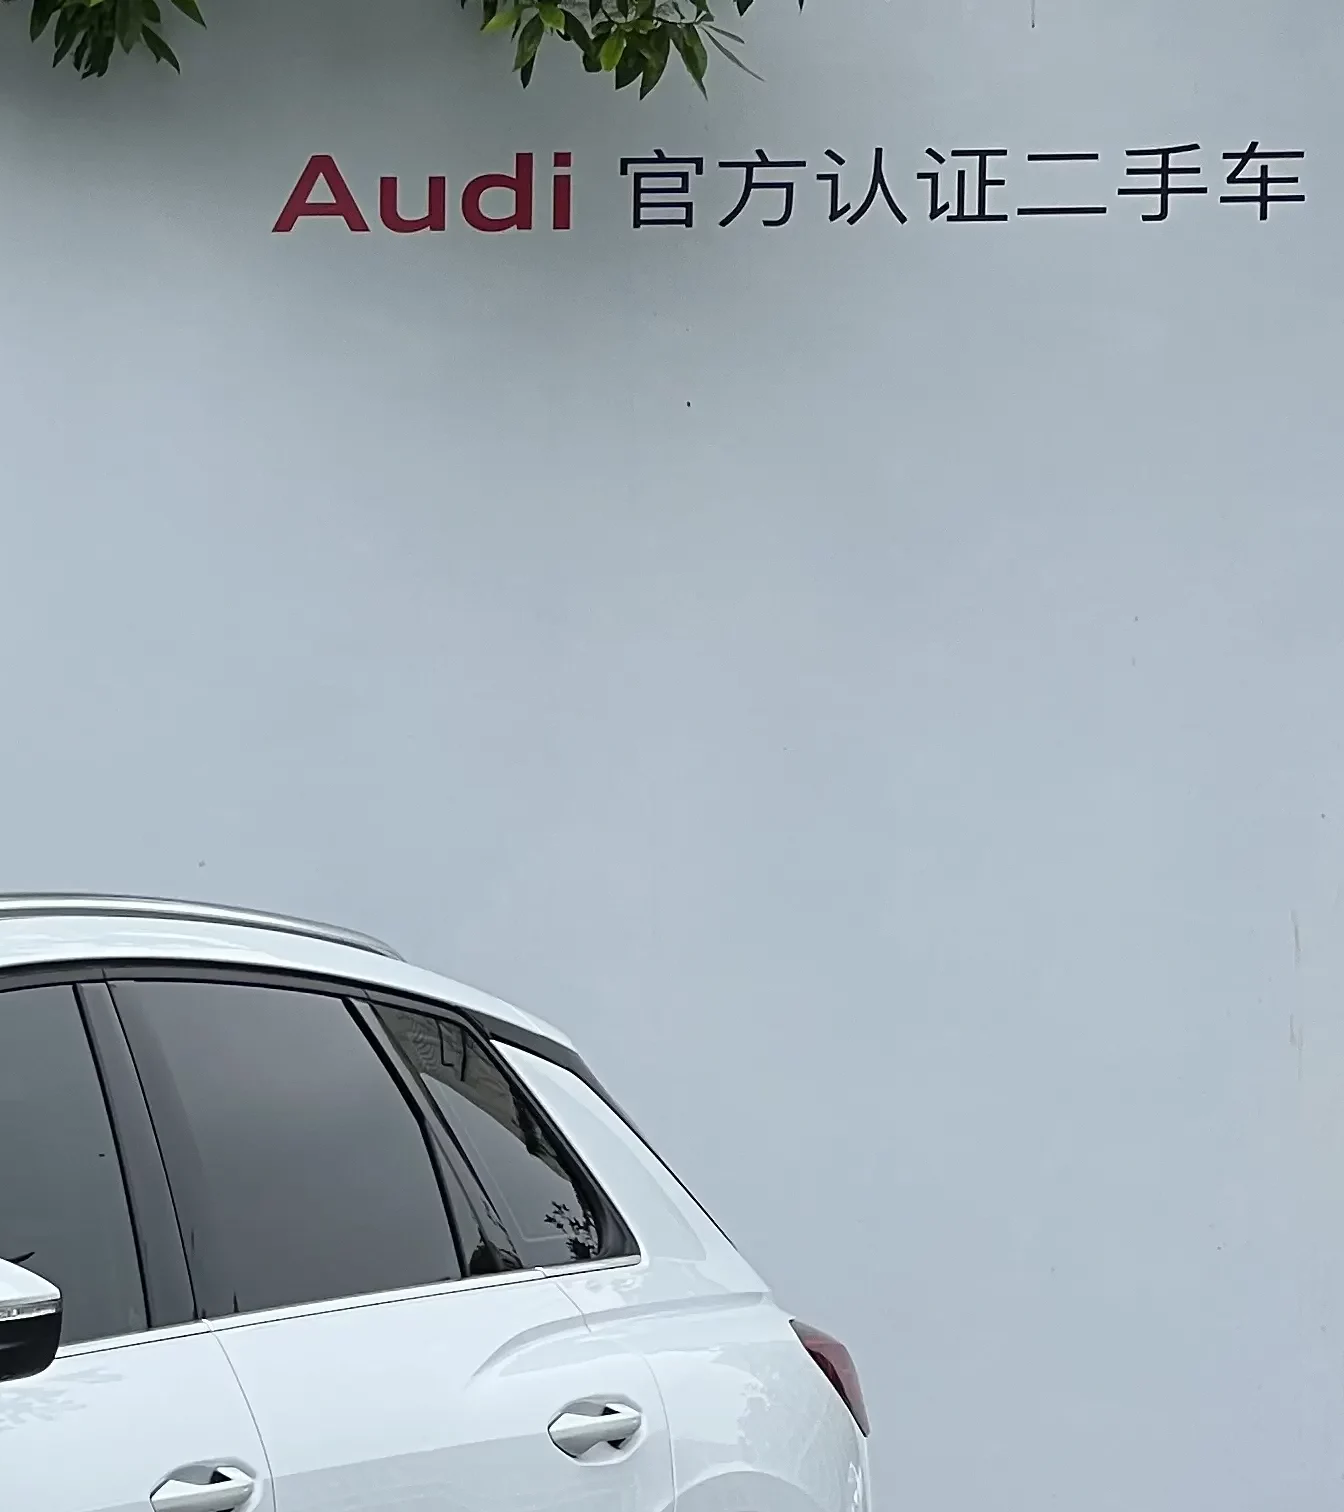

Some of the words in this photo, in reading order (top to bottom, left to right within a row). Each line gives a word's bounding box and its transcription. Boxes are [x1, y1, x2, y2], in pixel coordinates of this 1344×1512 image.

[270, 151, 574, 235] Audi
[618, 140, 1307, 229] 官方认证二手车
